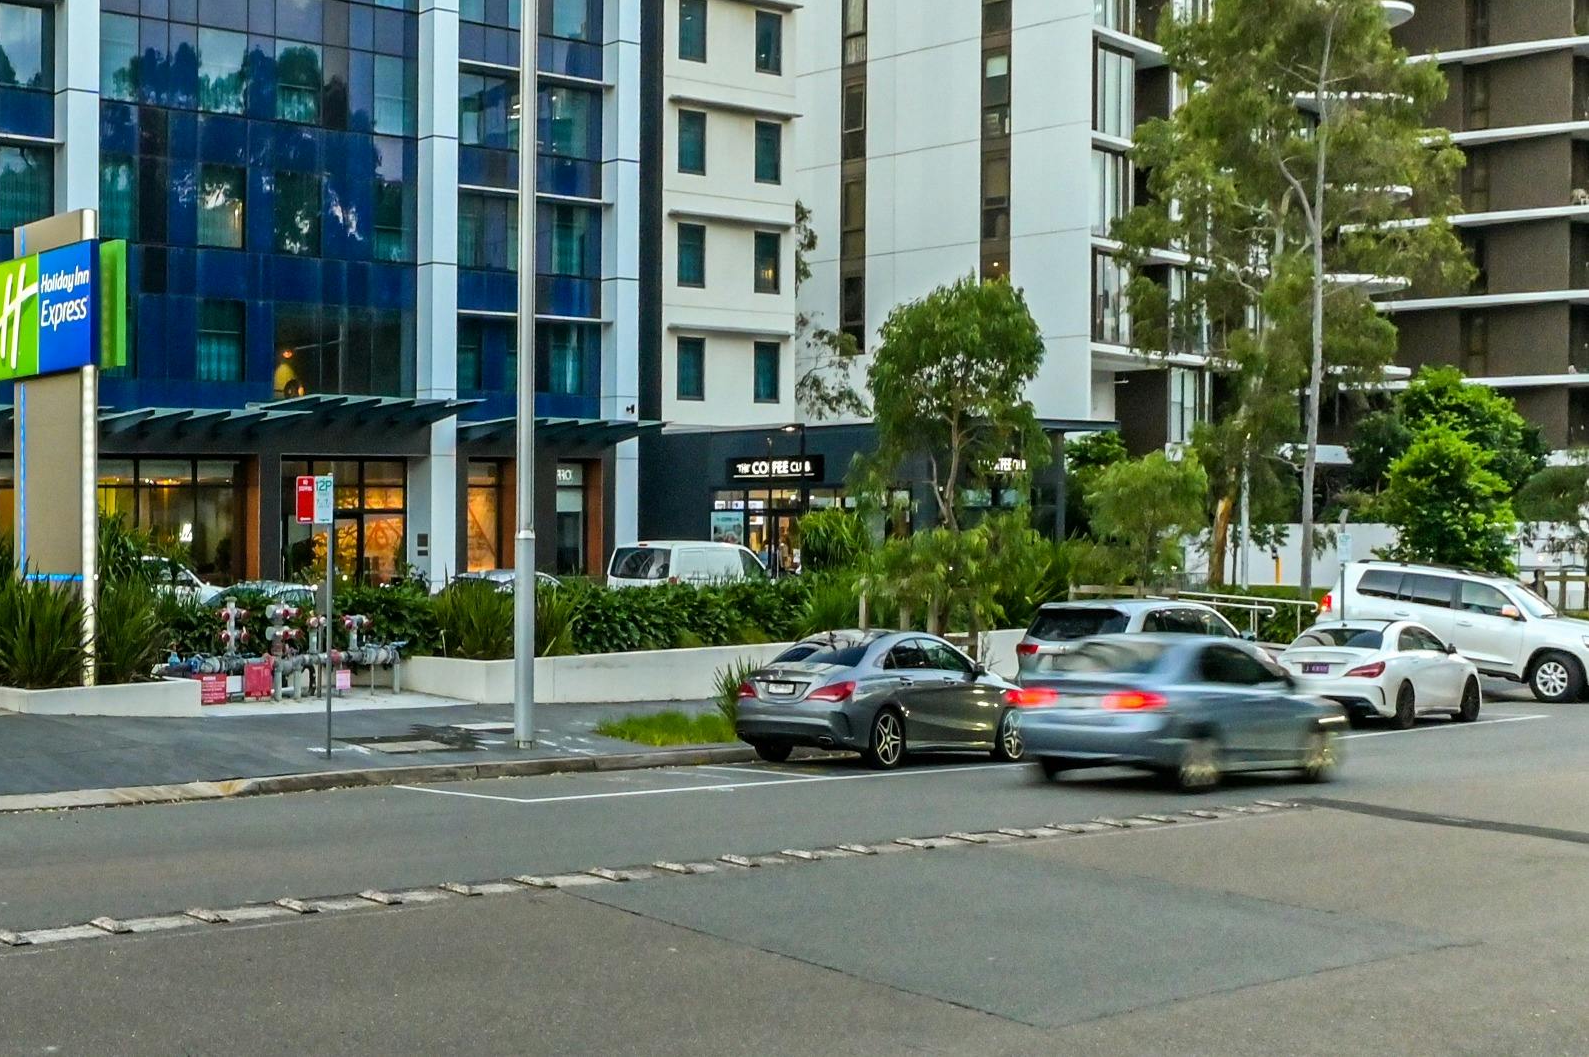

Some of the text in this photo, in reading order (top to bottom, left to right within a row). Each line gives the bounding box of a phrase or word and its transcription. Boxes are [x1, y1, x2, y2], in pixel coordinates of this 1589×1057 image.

[41, 265, 89, 294] Holiday Inn
[41, 297, 87, 331] Express
[736, 462, 751, 474] THE
[316, 480, 332, 492] 12P
